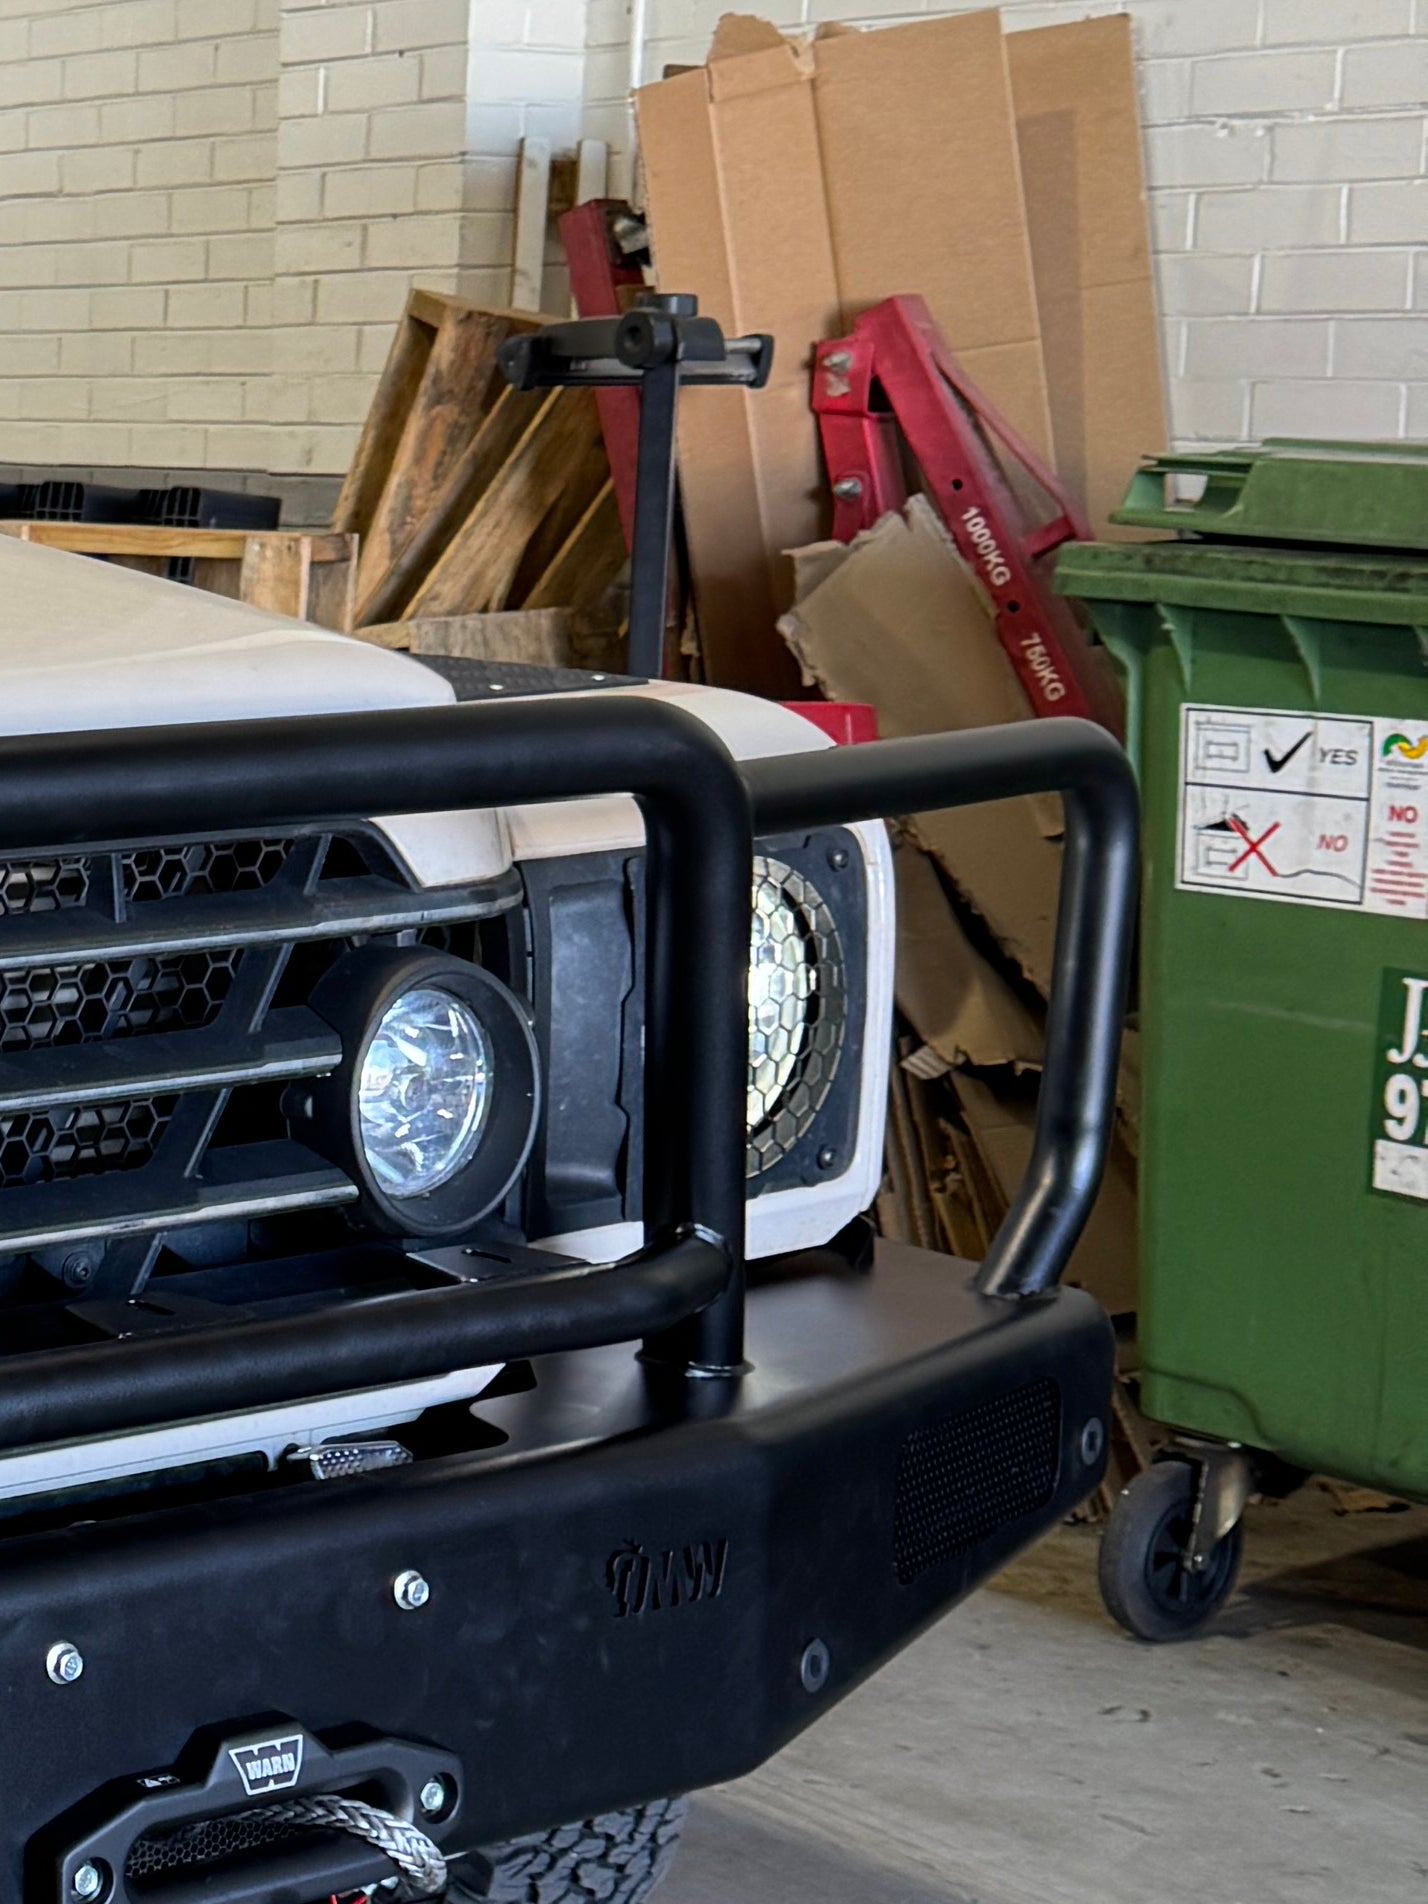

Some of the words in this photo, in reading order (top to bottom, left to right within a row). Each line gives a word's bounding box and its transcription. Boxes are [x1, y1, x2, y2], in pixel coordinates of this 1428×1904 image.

[960, 506, 1011, 587] 1000KG
[1318, 747, 1359, 766] YES
[1387, 805, 1418, 824] NO
[1316, 834, 1349, 853] NO
[1386, 977, 1428, 1069] J
[1383, 1073, 1428, 1145] 9
[245, 1752, 296, 1781] WARN
